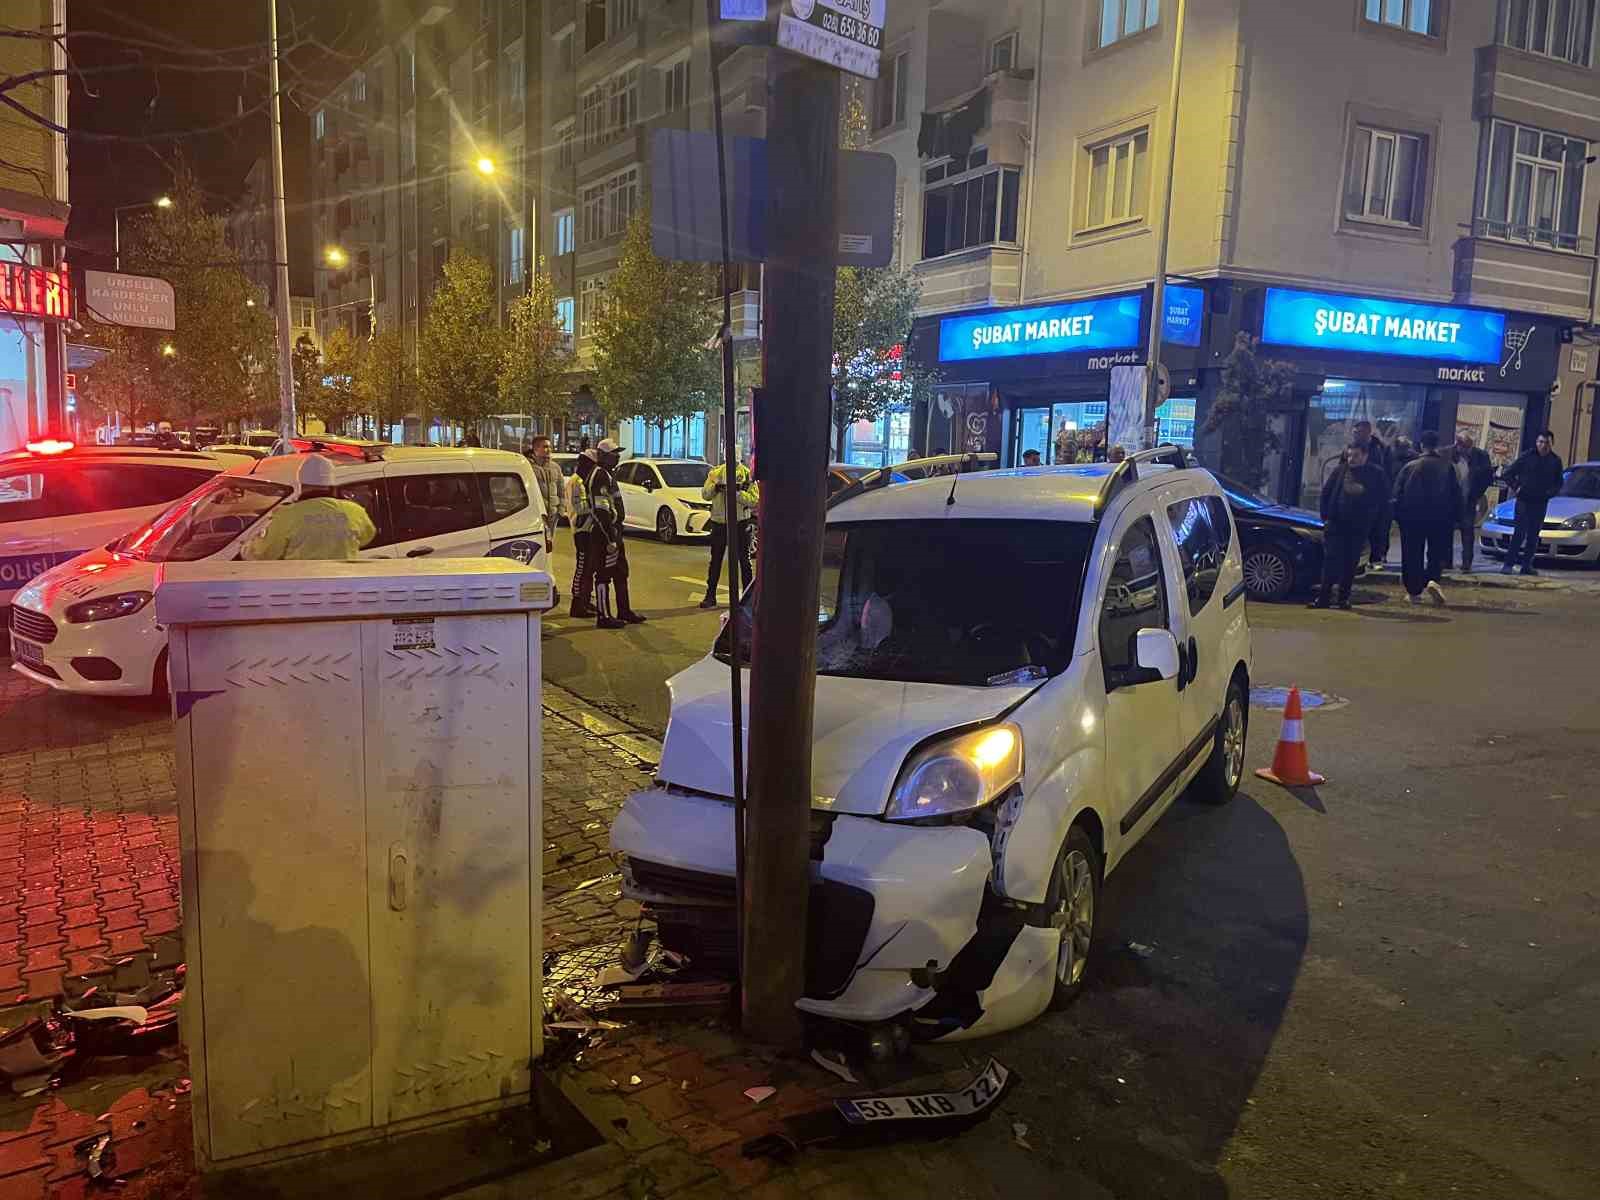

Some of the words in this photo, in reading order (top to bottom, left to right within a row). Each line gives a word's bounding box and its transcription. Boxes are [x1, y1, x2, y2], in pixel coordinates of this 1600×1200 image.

[840, 15, 856, 39] 654
[856, 22, 867, 43] 36
[867, 27, 880, 47] 60
[972, 322, 1021, 349] ŞUBAT
[1025, 315, 1094, 340] MARKET
[1314, 308, 1381, 336] ŞUBAT
[1384, 318, 1460, 344] MARKET
[1437, 366, 1485, 384] market
[855, 1101, 894, 1118] 59
[905, 1096, 955, 1117] AKB
